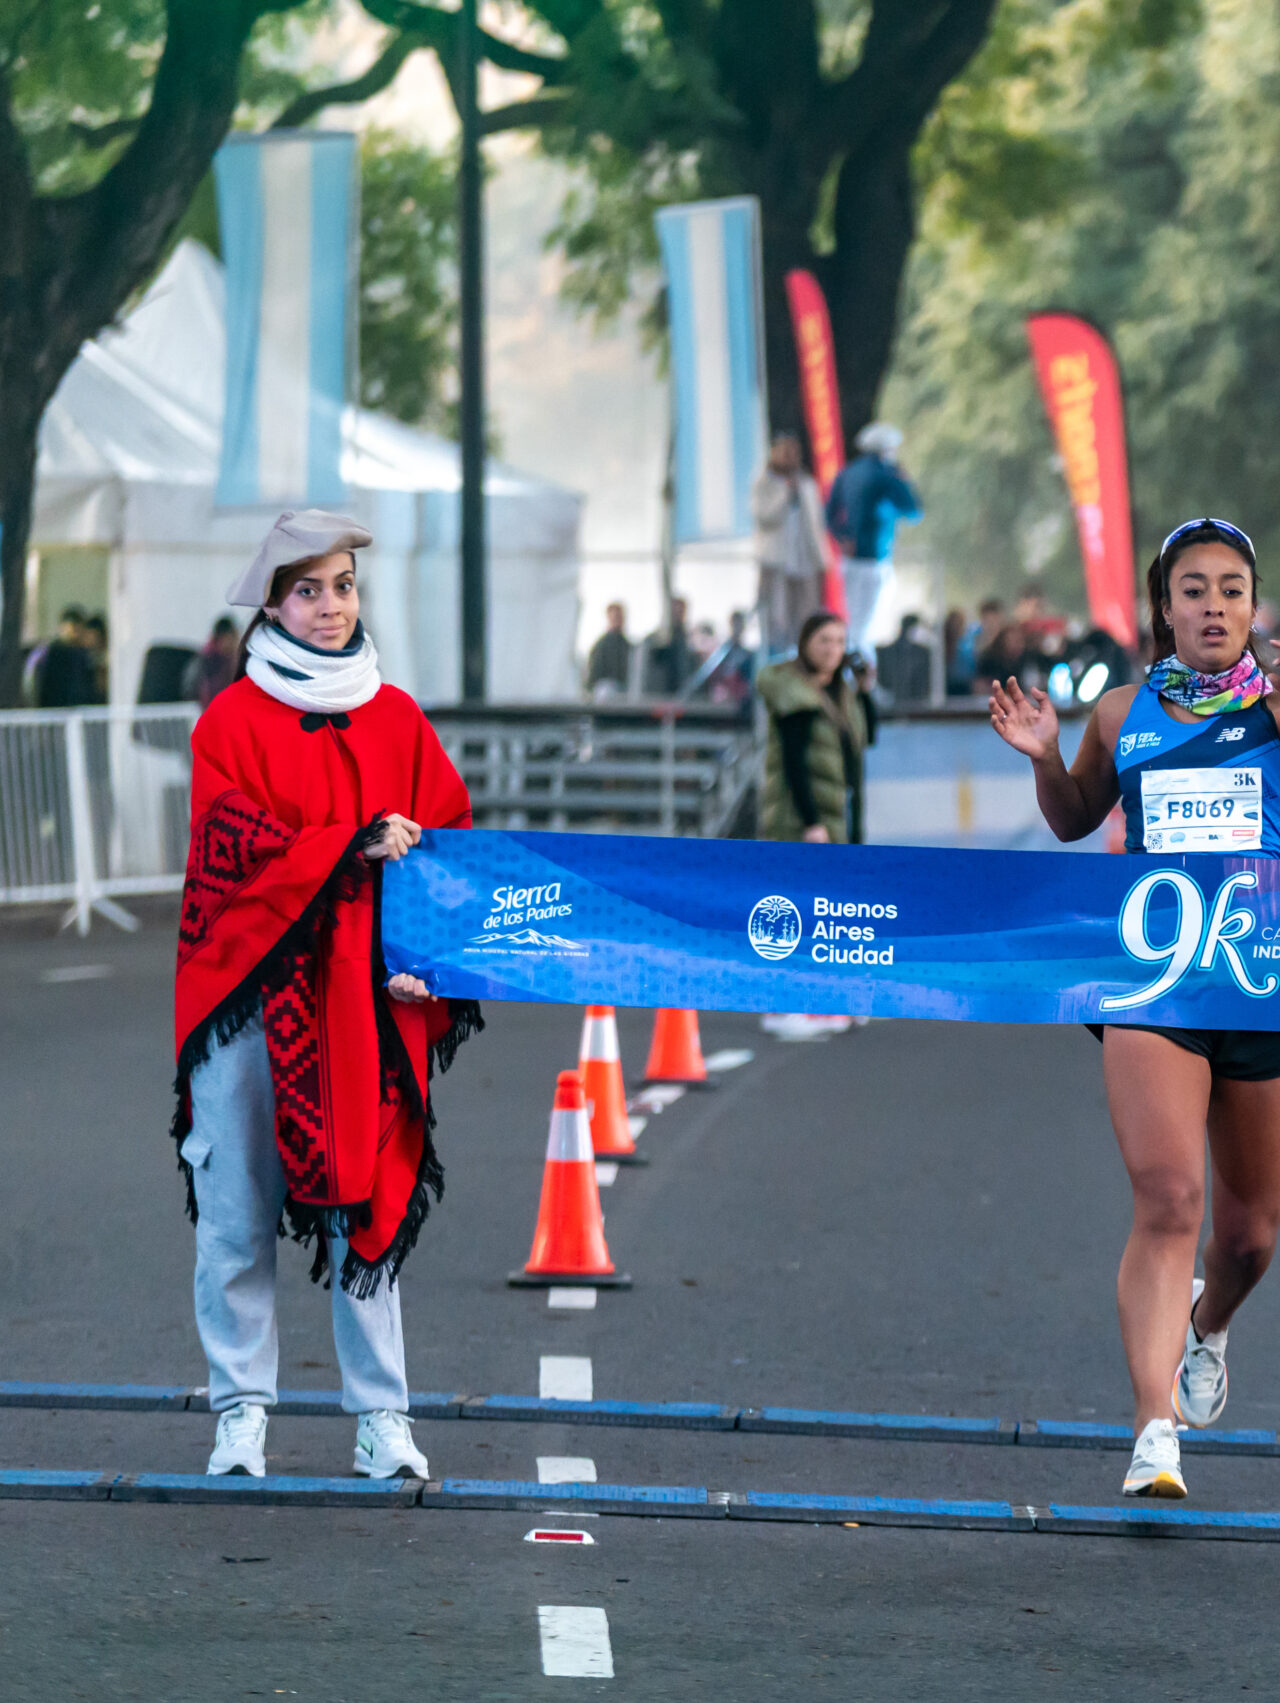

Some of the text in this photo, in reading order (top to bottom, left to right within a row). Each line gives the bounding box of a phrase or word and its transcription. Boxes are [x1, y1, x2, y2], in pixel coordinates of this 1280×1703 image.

[1234, 772, 1257, 787] 3K
[1167, 798, 1235, 820] F8069
[490, 882, 562, 913] Sierra
[813, 896, 898, 919] Buenos
[483, 903, 573, 930] de los Padres
[811, 920, 875, 942] Aires
[811, 943, 894, 966] Ciudad
